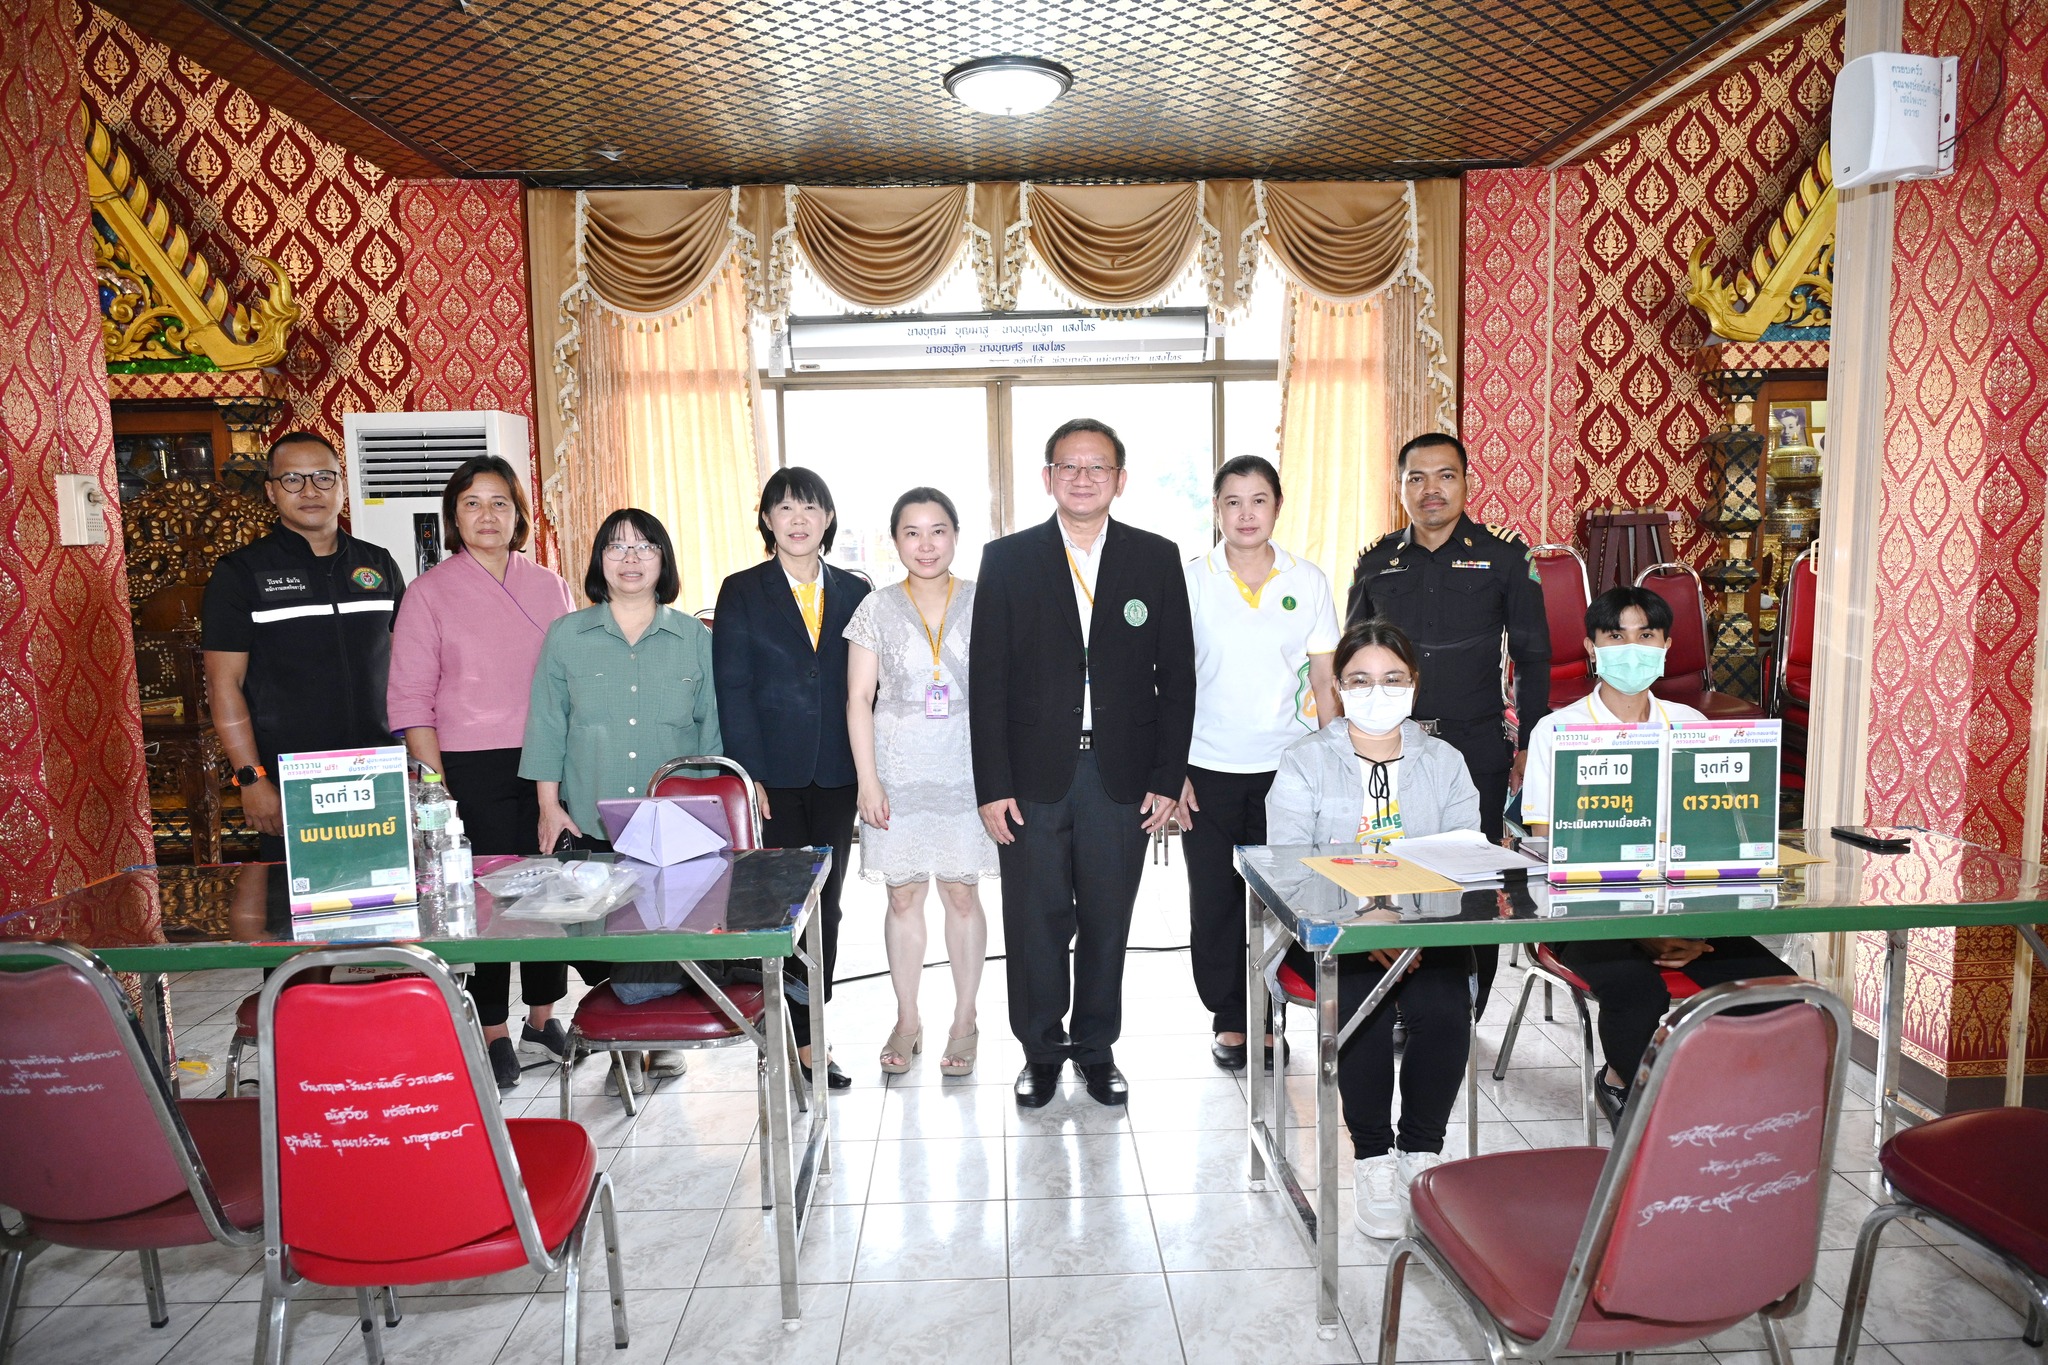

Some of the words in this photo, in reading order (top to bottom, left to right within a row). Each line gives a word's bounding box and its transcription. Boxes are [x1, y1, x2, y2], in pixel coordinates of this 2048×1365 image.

[979, 341, 1024, 355] นางบุญศรี
[1555, 733, 1589, 741] คาราวาน
[1672, 731, 1706, 739] คาราวาน
[283, 761, 322, 771] คาราวาน
[1579, 757, 1608, 780] จุดที่
[1613, 762, 1629, 776] 10
[1700, 756, 1730, 778] จุดที่
[1734, 761, 1743, 774] 9
[314, 784, 347, 809] จุดที่
[353, 789, 371, 802] 13
[1576, 794, 1634, 814] ตรวจหู
[1682, 793, 1760, 811] ตรวจตา
[299, 816, 397, 843] พบแพทย์
[1555, 815, 1652, 830] ประเมินความเมื่อยล้า
